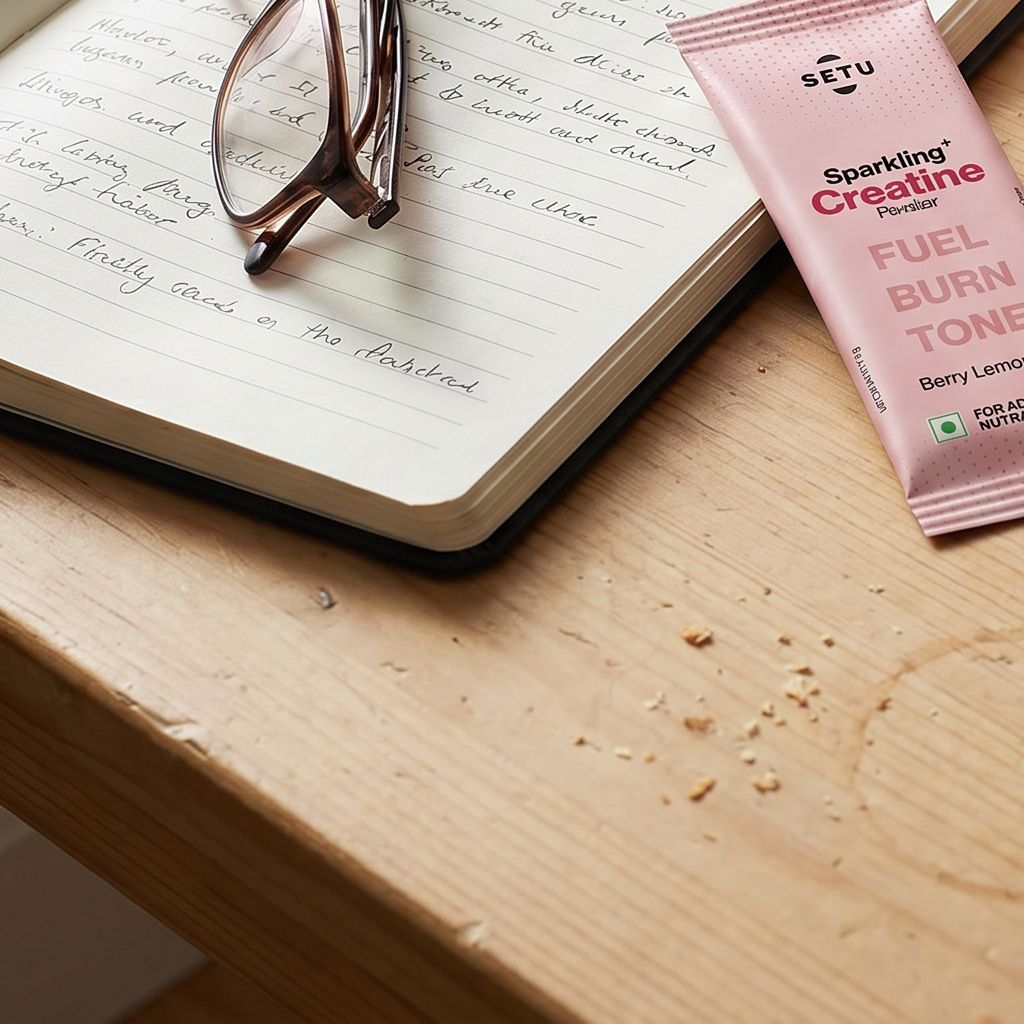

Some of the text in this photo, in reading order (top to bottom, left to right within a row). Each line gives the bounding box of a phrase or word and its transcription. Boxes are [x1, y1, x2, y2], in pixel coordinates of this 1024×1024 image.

[801, 60, 875, 88] SETU
[811, 163, 986, 215] Creatine
[867, 225, 990, 270] FUEL
[886, 260, 1017, 313] BURN
[918, 370, 968, 391] Berry
[973, 404, 1006, 420] FOR
